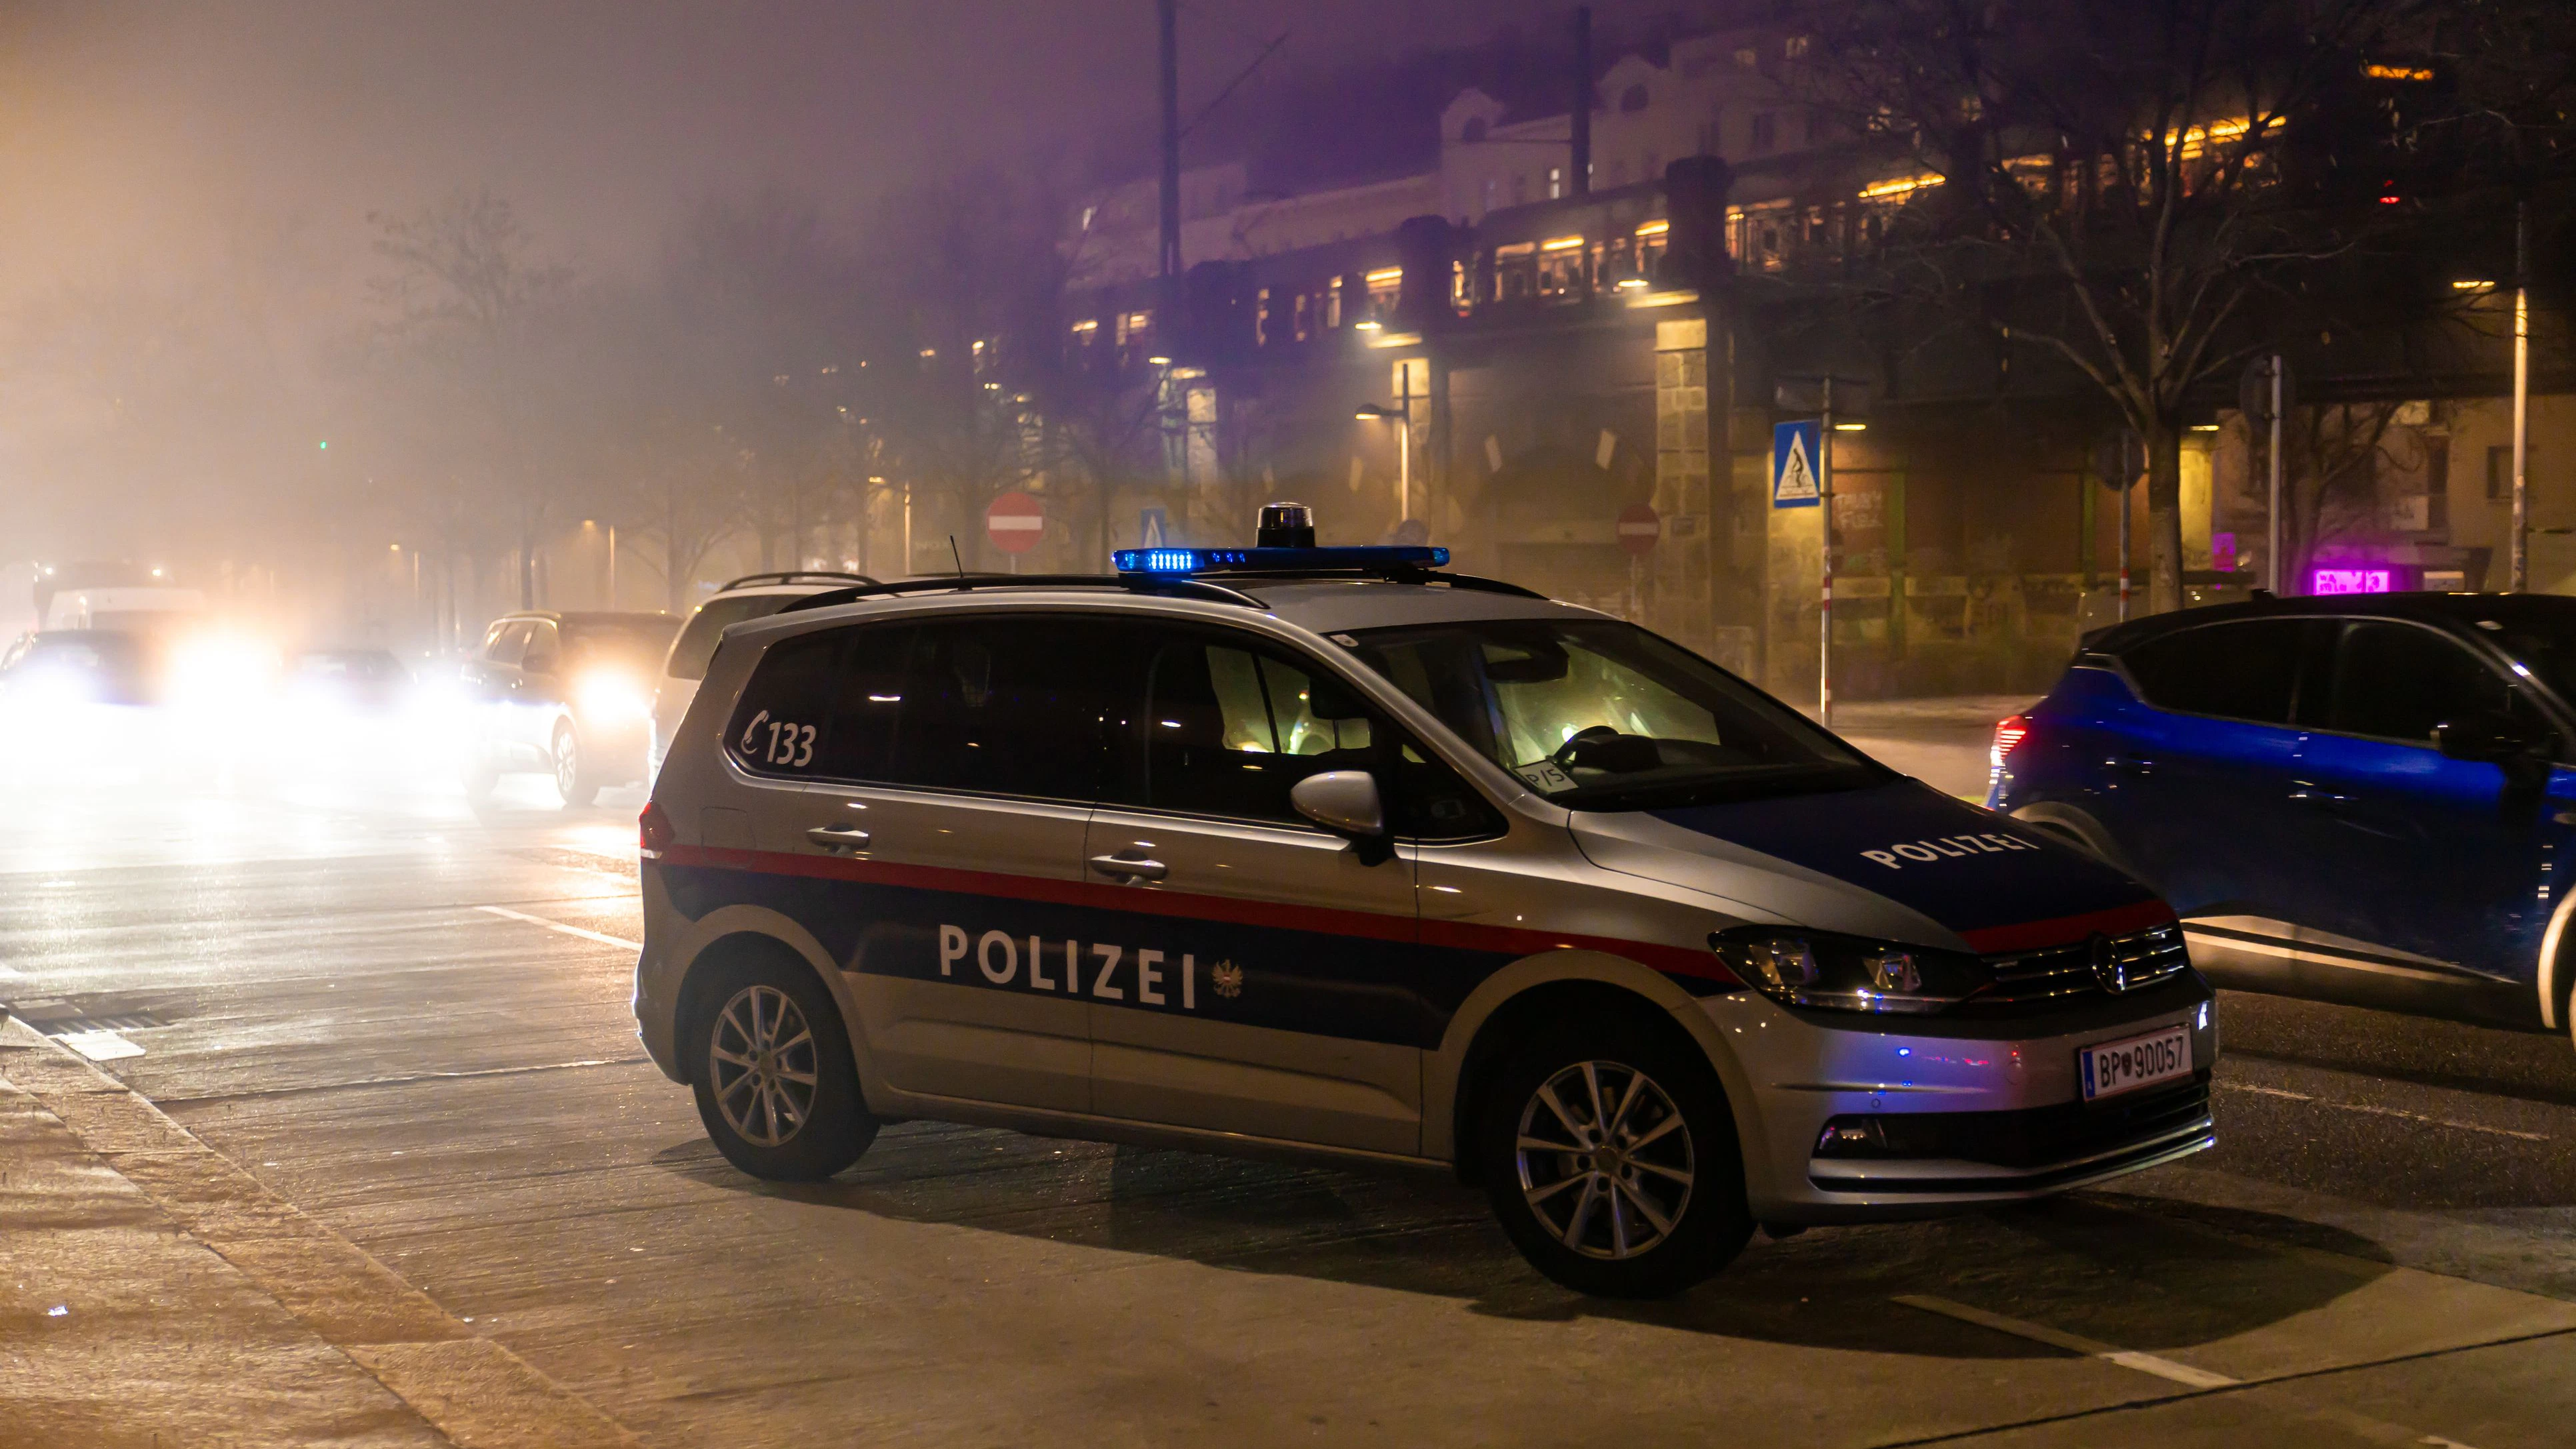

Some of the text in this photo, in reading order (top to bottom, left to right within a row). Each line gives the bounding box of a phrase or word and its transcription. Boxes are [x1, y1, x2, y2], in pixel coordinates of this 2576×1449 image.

[767, 721, 817, 767] 133
[1859, 834, 2042, 869] POLIZEI
[939, 924, 1195, 1009] POLIZEI
[2100, 1035, 2184, 1088] BP 90057
